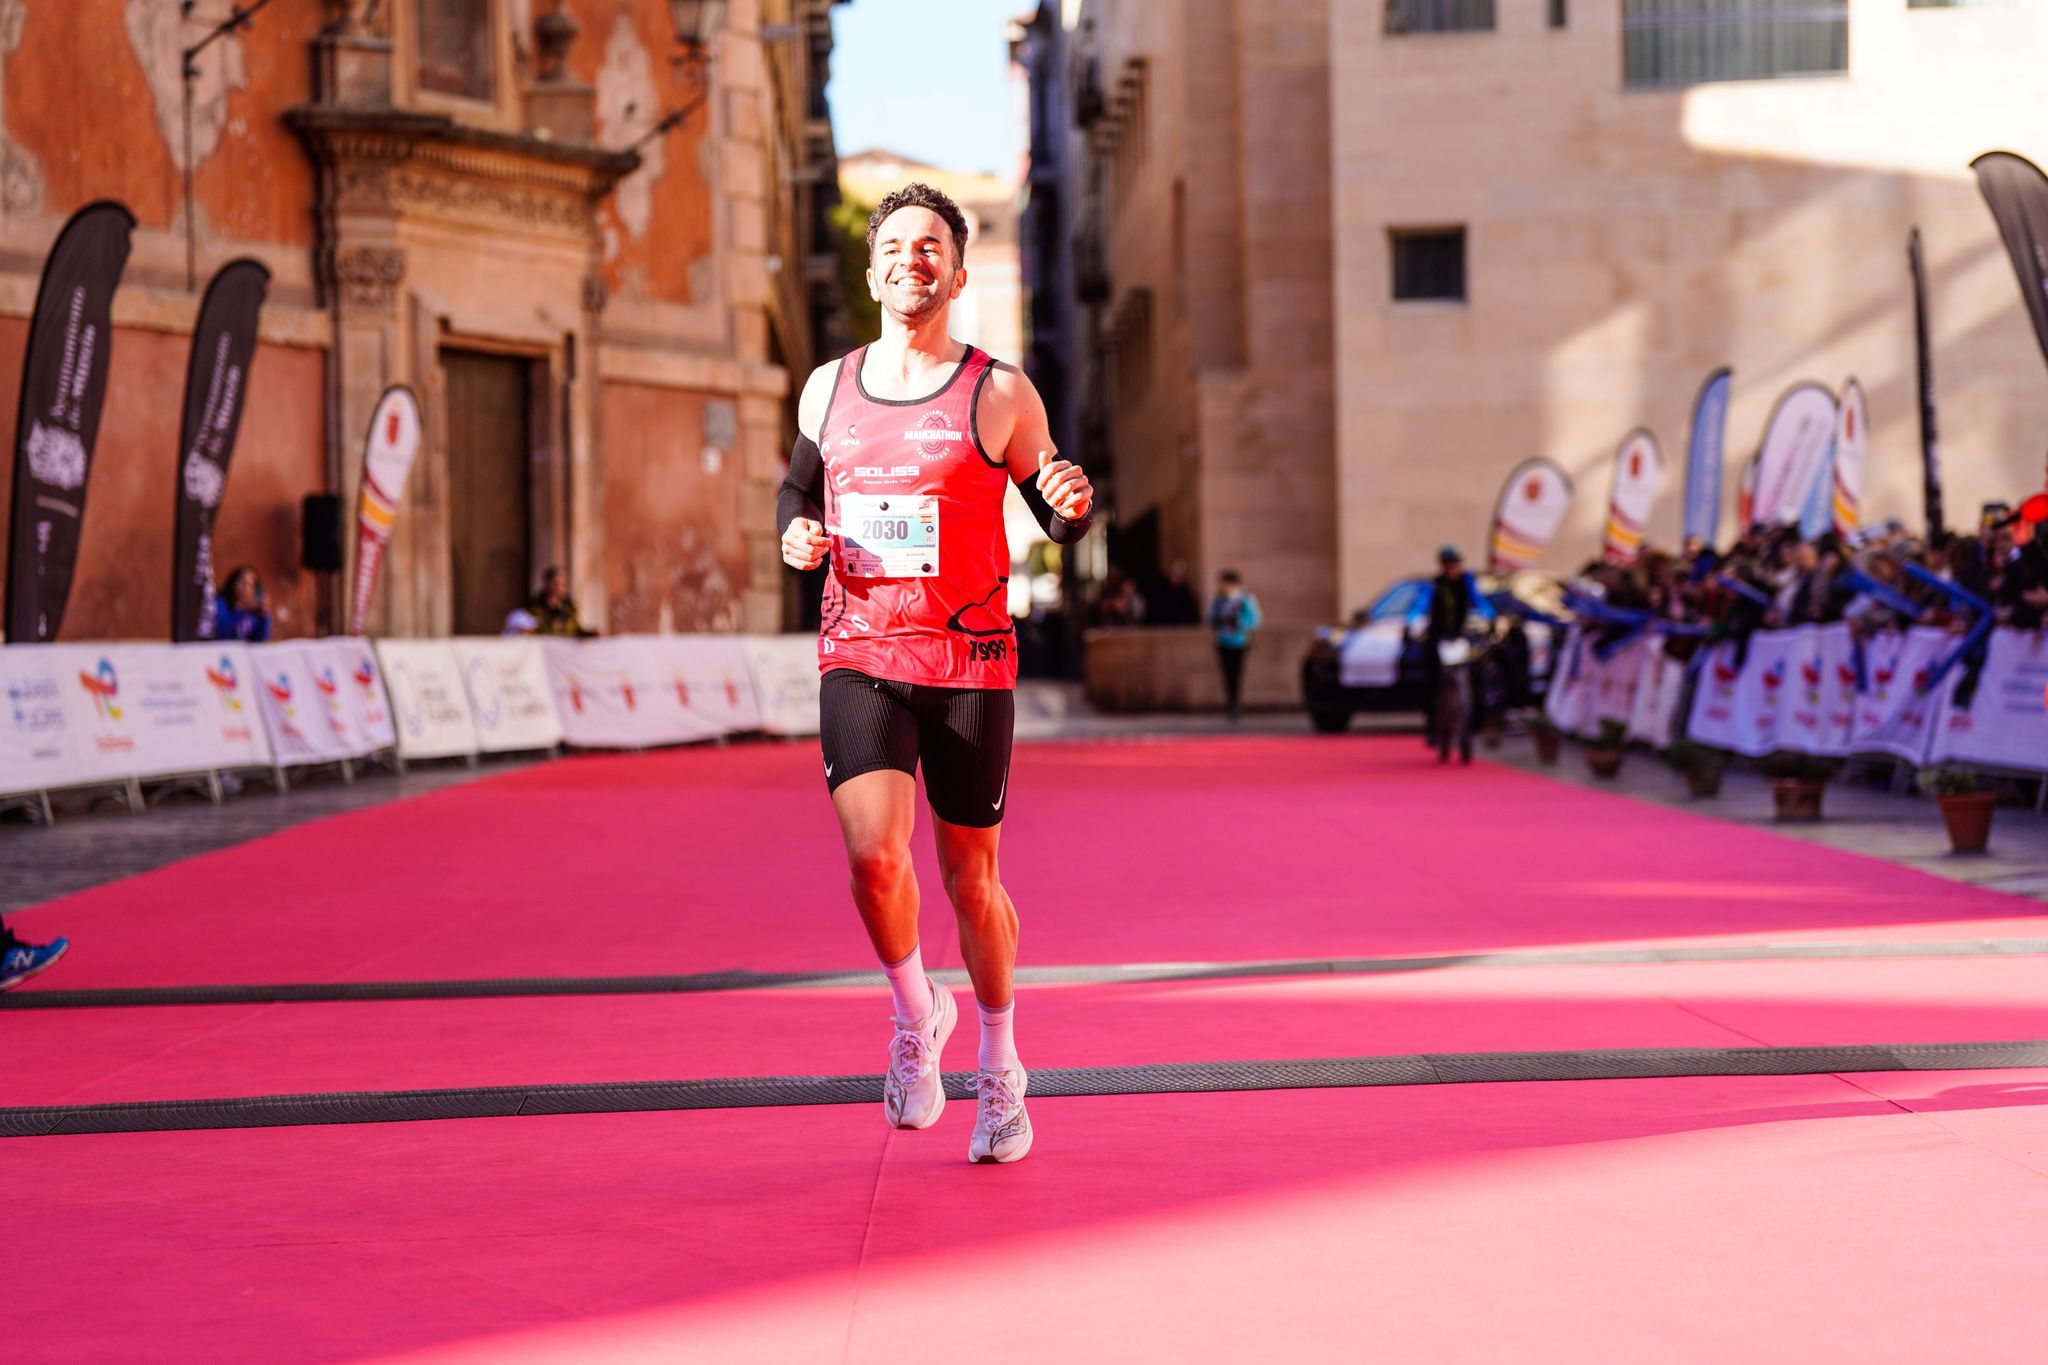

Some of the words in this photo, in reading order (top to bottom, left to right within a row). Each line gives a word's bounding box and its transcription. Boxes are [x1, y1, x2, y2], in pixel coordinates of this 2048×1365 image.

[904, 430, 962, 441] MANCHATHON
[854, 466, 920, 477] SOLISS
[862, 519, 909, 540] 2030
[969, 638, 1007, 661] 1999
